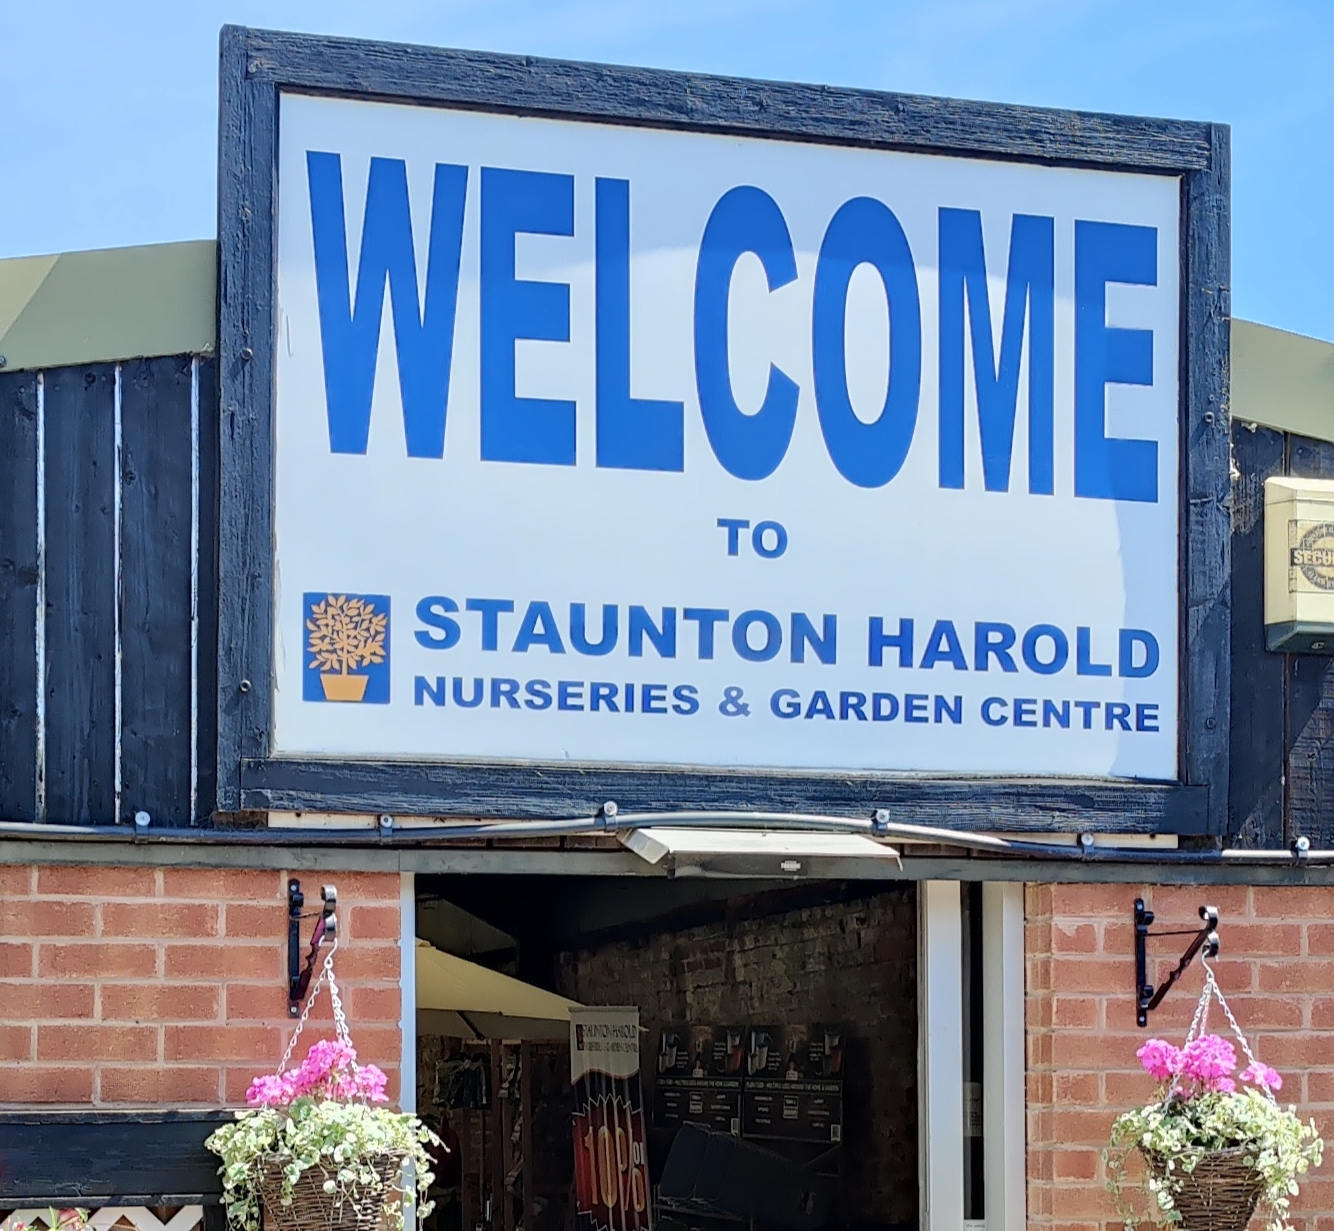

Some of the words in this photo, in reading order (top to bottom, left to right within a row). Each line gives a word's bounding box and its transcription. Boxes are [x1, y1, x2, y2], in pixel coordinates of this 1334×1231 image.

[306, 150, 1160, 504] WELCOME
[716, 518, 788, 559] TO
[413, 595, 838, 665] STAUNTON
[867, 616, 1160, 679] HAROLD
[414, 675, 700, 716] NURSERIES
[718, 686, 751, 718] &
[769, 688, 963, 725] GARDEN
[980, 696, 1160, 733] CENTRE
